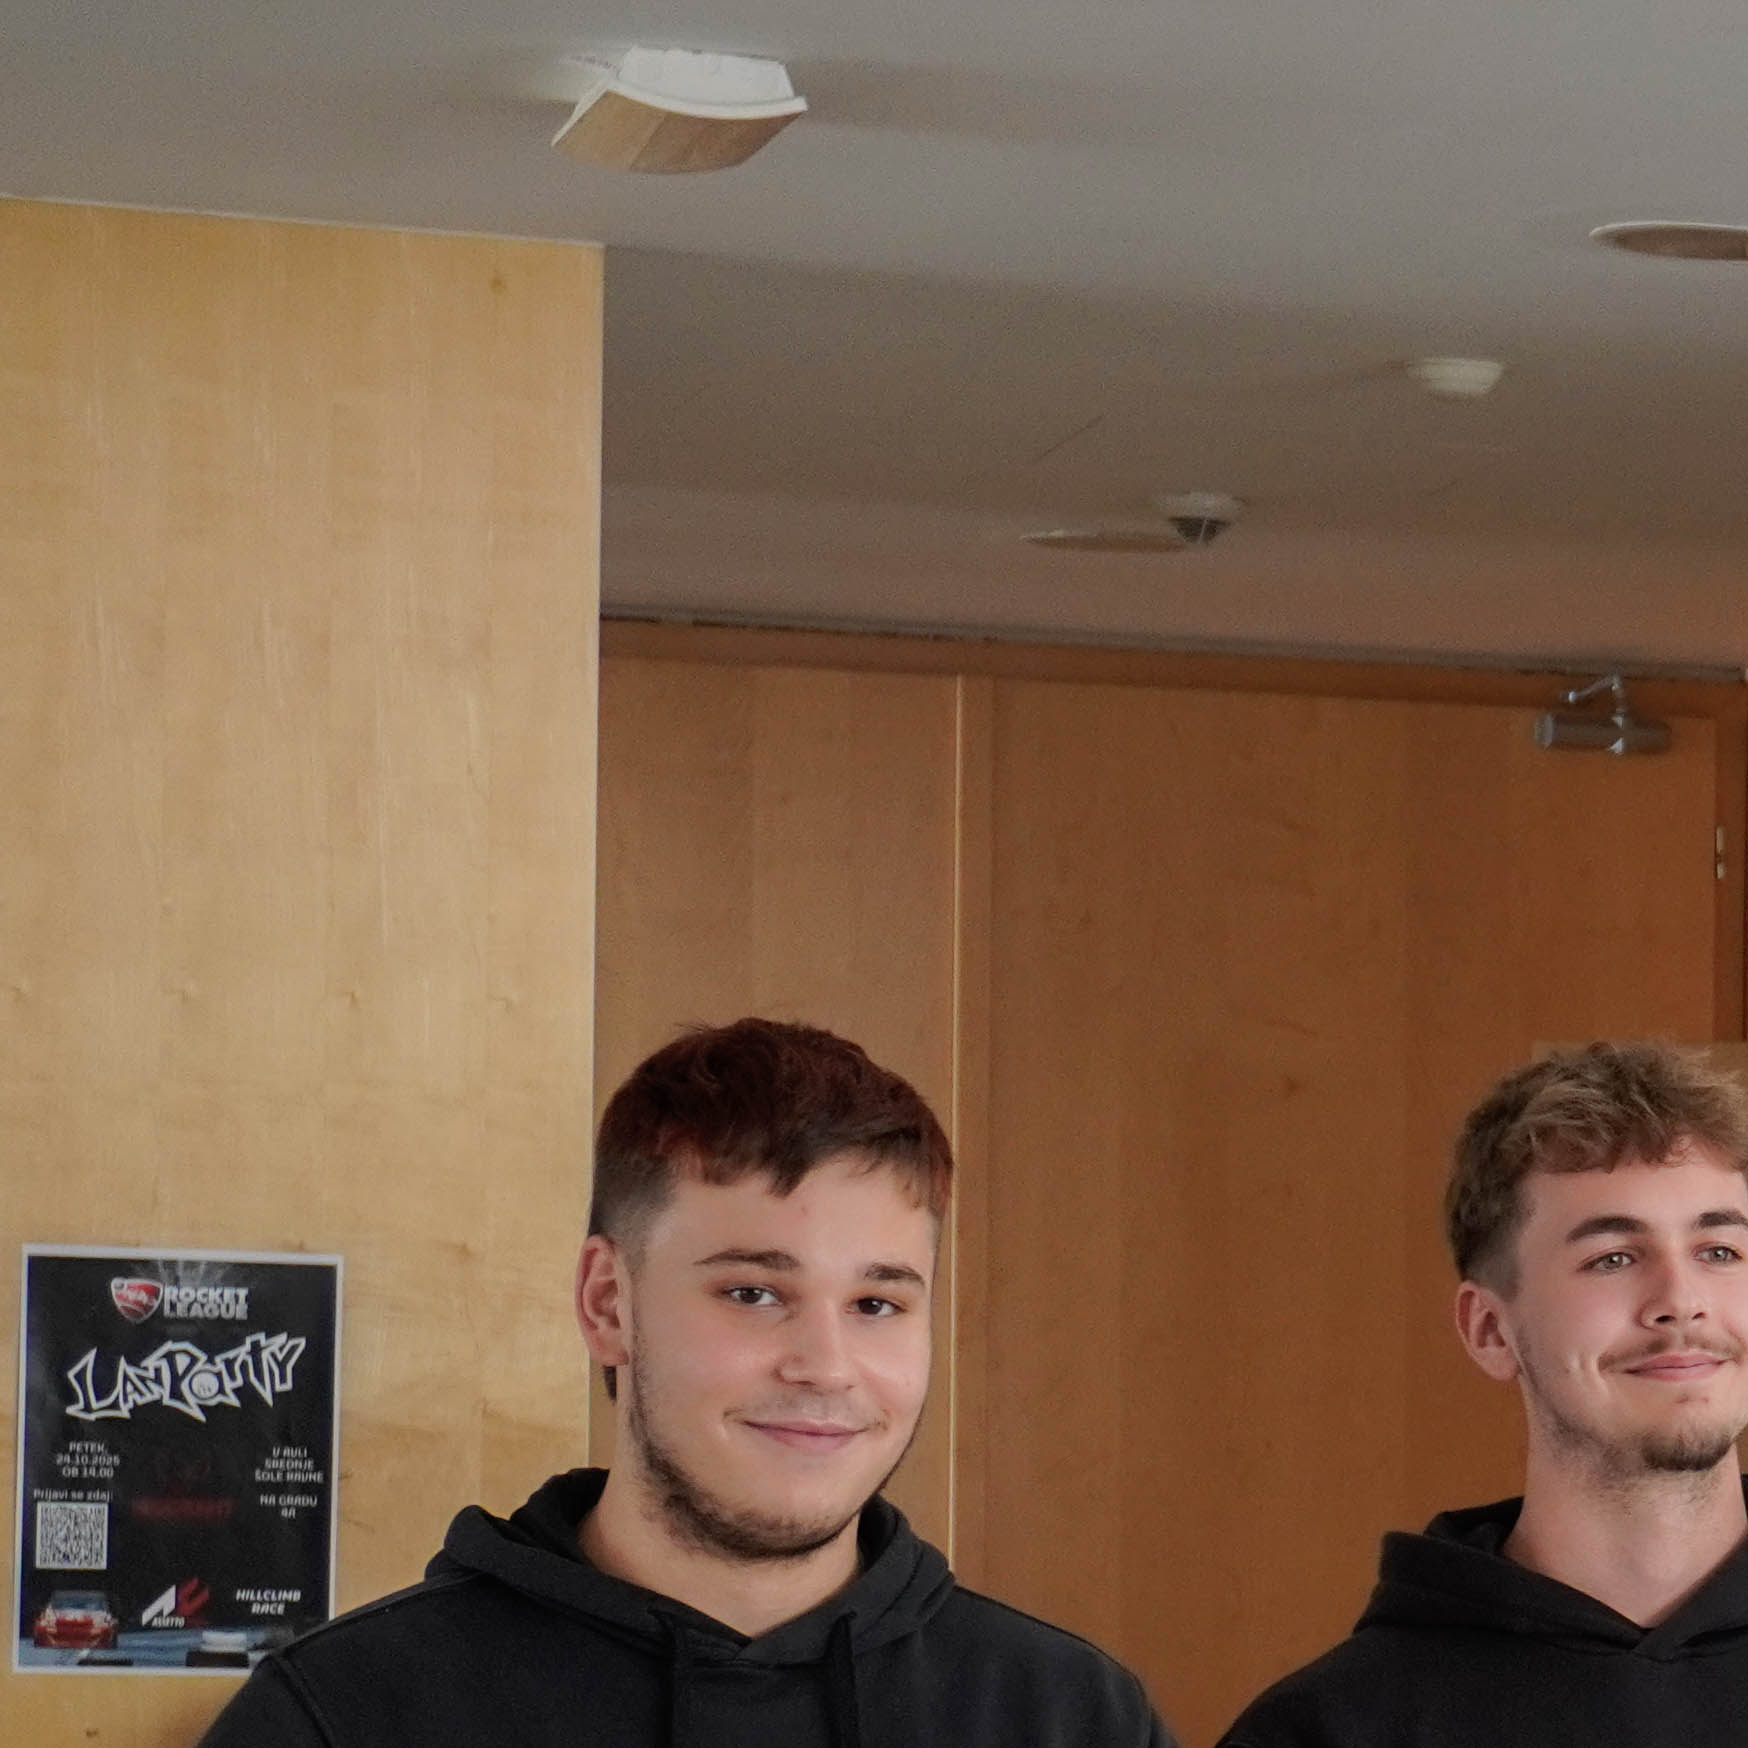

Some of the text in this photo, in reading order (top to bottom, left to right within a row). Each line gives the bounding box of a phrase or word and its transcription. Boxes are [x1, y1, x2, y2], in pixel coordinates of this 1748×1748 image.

[163, 1285, 249, 1304] ROCKET
[163, 1302, 248, 1321] LEAGUE
[251, 1602, 286, 1616] RACE
